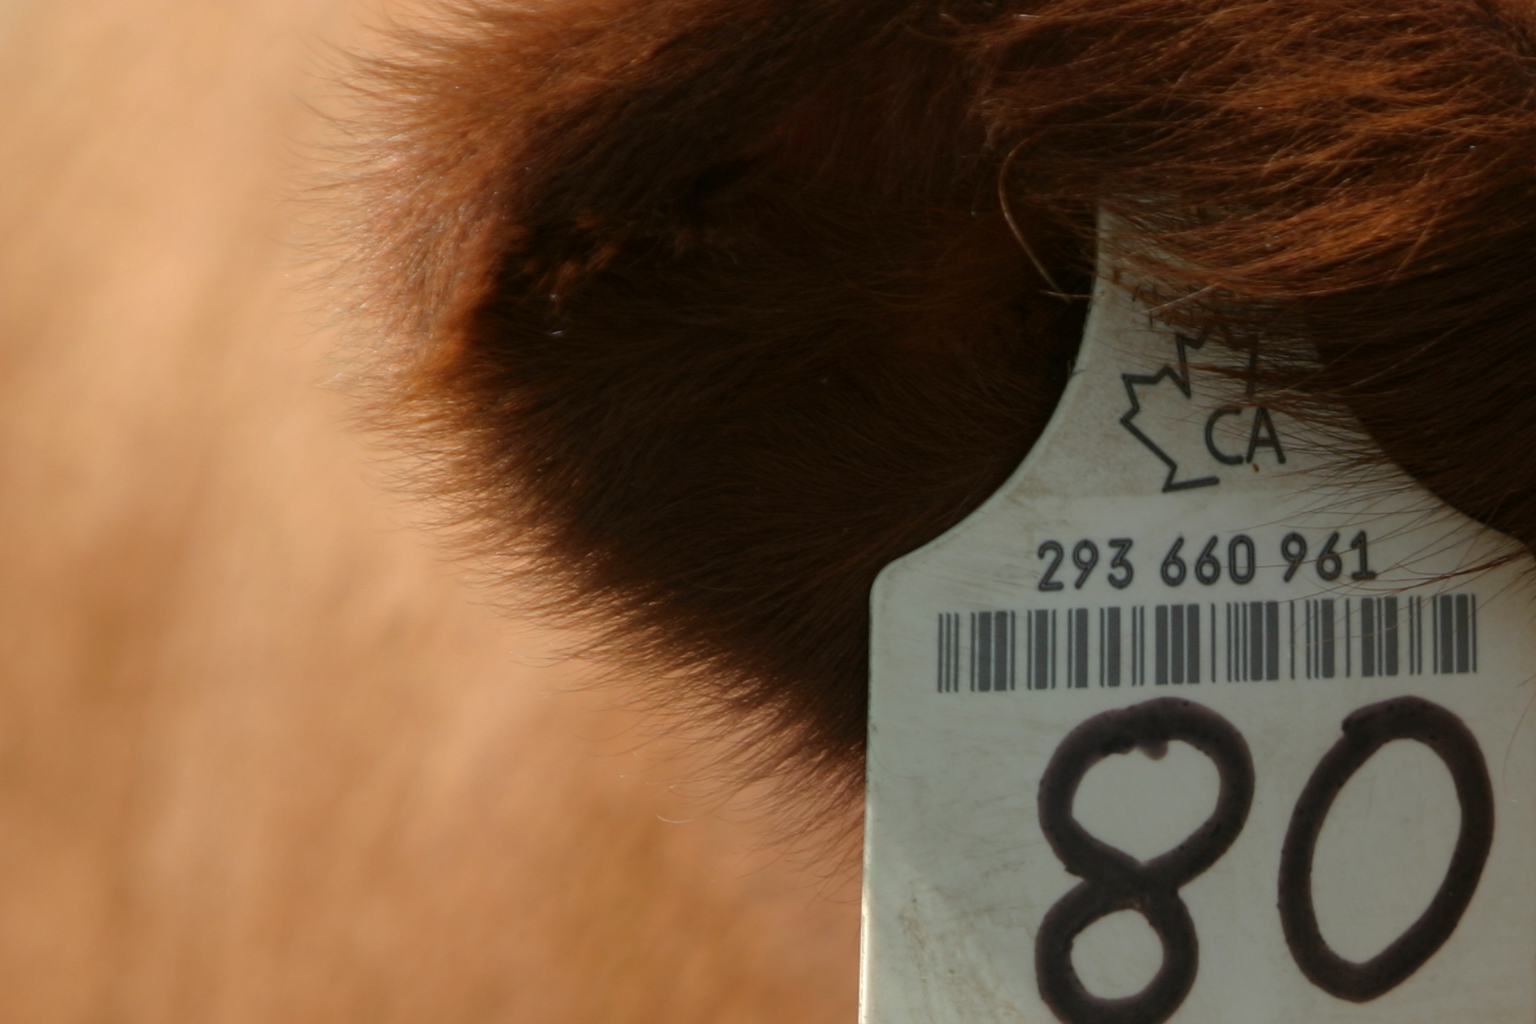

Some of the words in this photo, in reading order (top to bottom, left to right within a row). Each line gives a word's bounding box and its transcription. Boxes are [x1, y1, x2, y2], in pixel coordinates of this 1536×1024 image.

[1205, 405, 1286, 465] CA
[1037, 539, 1134, 592] 293
[1160, 534, 1257, 588] 660
[1280, 530, 1377, 582] 961
